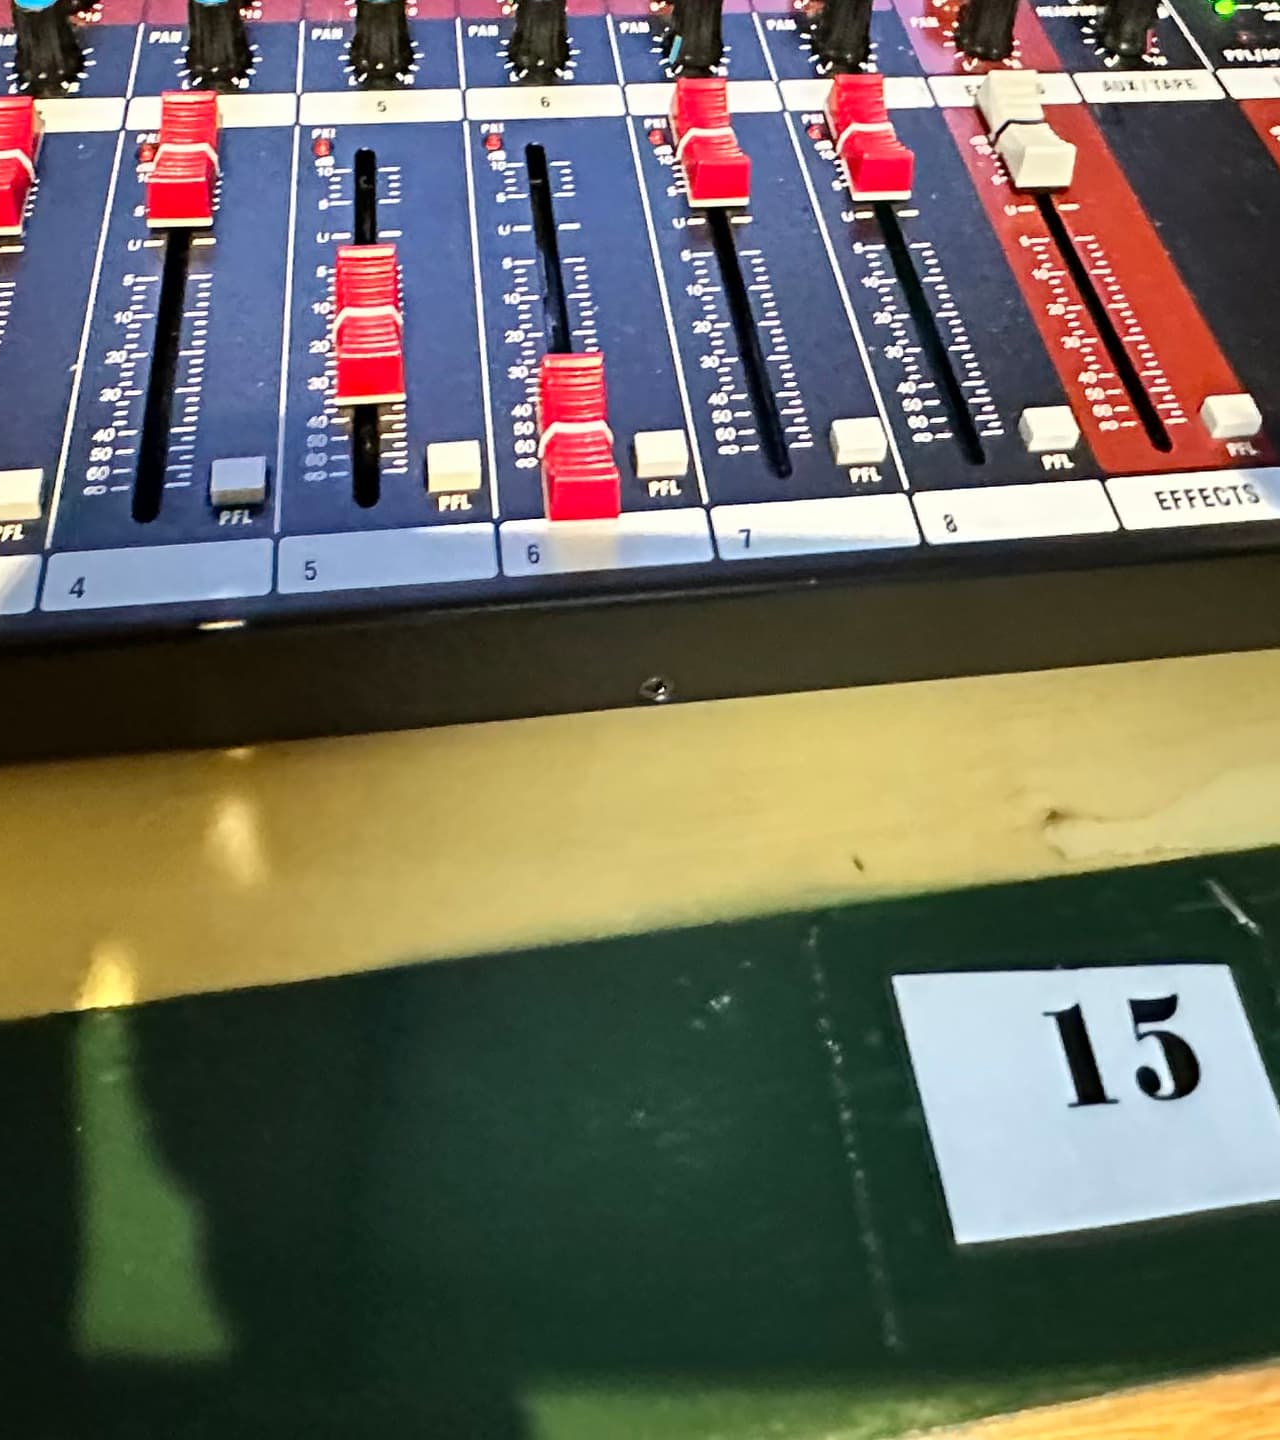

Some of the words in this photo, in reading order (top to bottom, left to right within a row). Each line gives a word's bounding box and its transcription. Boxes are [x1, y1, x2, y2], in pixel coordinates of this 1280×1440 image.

[148, 30, 183, 44] PAN
[310, 27, 344, 40] PAN
[467, 24, 499, 37] PAN
[376, 100, 388, 113] 5
[540, 96, 551, 109] 6
[315, 166, 335, 178] 10
[315, 231, 331, 244] U
[497, 224, 513, 236] U
[126, 238, 143, 251] U
[685, 283, 704, 297] 10
[502, 292, 521, 305] 10
[310, 301, 331, 315] 10
[113, 309, 134, 324] 10
[871, 310, 893, 325] 20
[691, 320, 712, 334] 20
[504, 329, 525, 343] 20
[307, 339, 331, 354] 20
[104, 349, 128, 364] 20
[506, 366, 529, 380] 30
[306, 376, 331, 391] 30
[895, 380, 918, 395] 40
[98, 387, 123, 402] 30
[707, 392, 729, 406] 40
[510, 403, 533, 417] 40
[305, 414, 330, 428] 40
[512, 421, 535, 435] 50
[91, 427, 116, 443] 40
[88, 446, 114, 462] 50
[513, 440, 537, 454] 60
[85, 465, 111, 481] 60
[848, 466, 883, 485] PFL
[646, 479, 682, 498] PFL
[436, 494, 473, 513] PFL
[1153, 482, 1262, 512] EFFECTS
[219, 509, 254, 526] PFL
[942, 513, 959, 535] 8
[737, 527, 752, 549] 7
[526, 543, 541, 565] 6
[303, 559, 319, 581] 5
[68, 576, 86, 600] 4
[1042, 992, 1201, 1108] 15
